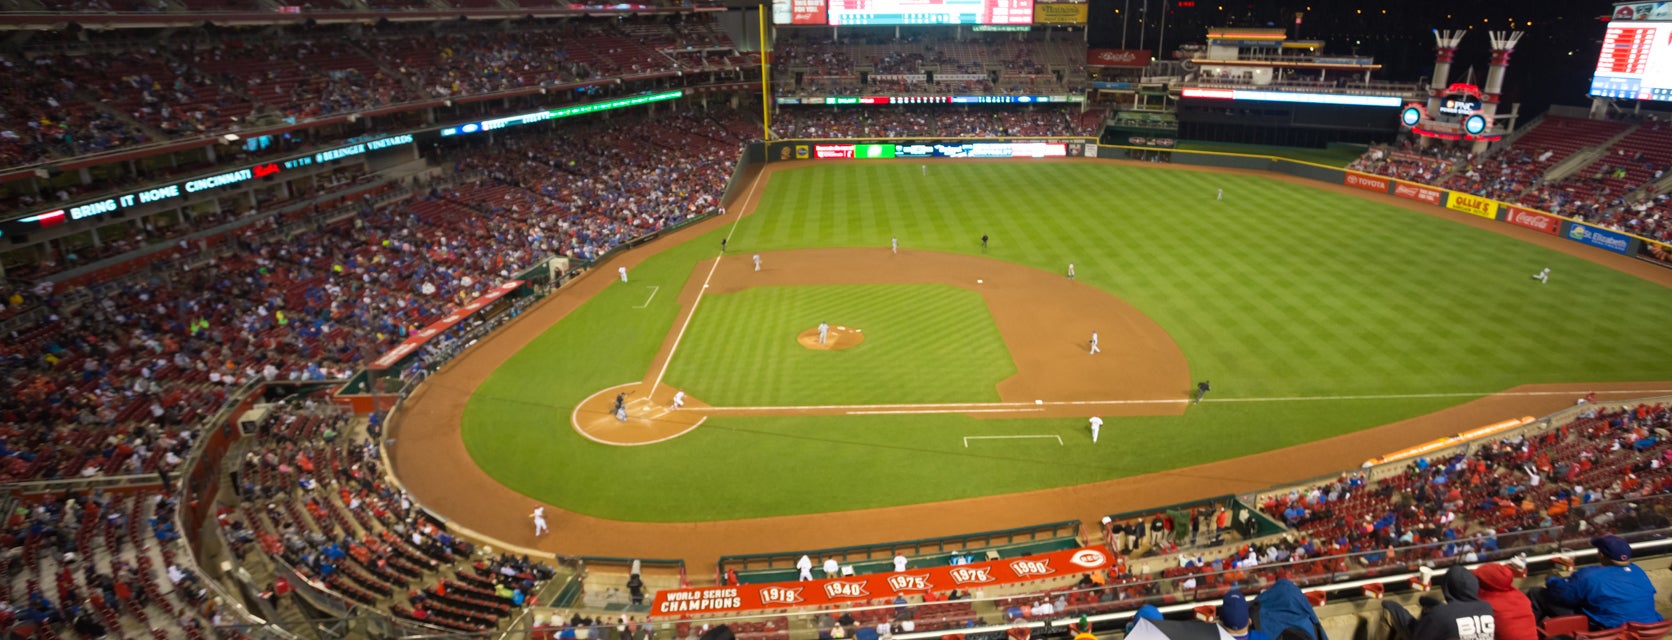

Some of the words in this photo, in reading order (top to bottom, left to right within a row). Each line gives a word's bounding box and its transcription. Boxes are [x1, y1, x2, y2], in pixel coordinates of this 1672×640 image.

[1454, 101, 1475, 112] PNC
[70, 199, 117, 220] BRING
[120, 194, 135, 208] IT
[139, 184, 179, 204] HOME
[185, 168, 252, 193] CINCINNATI
[284, 156, 312, 169] WITH
[366, 133, 414, 151] VINEYARDS
[1358, 178, 1385, 190] TOYOTA
[1455, 196, 1490, 213] OLLIE'S
[1515, 211, 1549, 230] Coca-Cola
[1592, 232, 1627, 249] Elizabeth
[1012, 561, 1046, 574] 1990
[891, 576, 924, 589] 1975
[953, 569, 986, 582] 1976
[666, 591, 702, 602] WORLD
[703, 588, 737, 600] SERIES
[763, 588, 795, 602] 1919
[826, 583, 860, 596] 1940
[660, 597, 741, 613] CHAMPIONS
[1456, 615, 1495, 635] BIG
